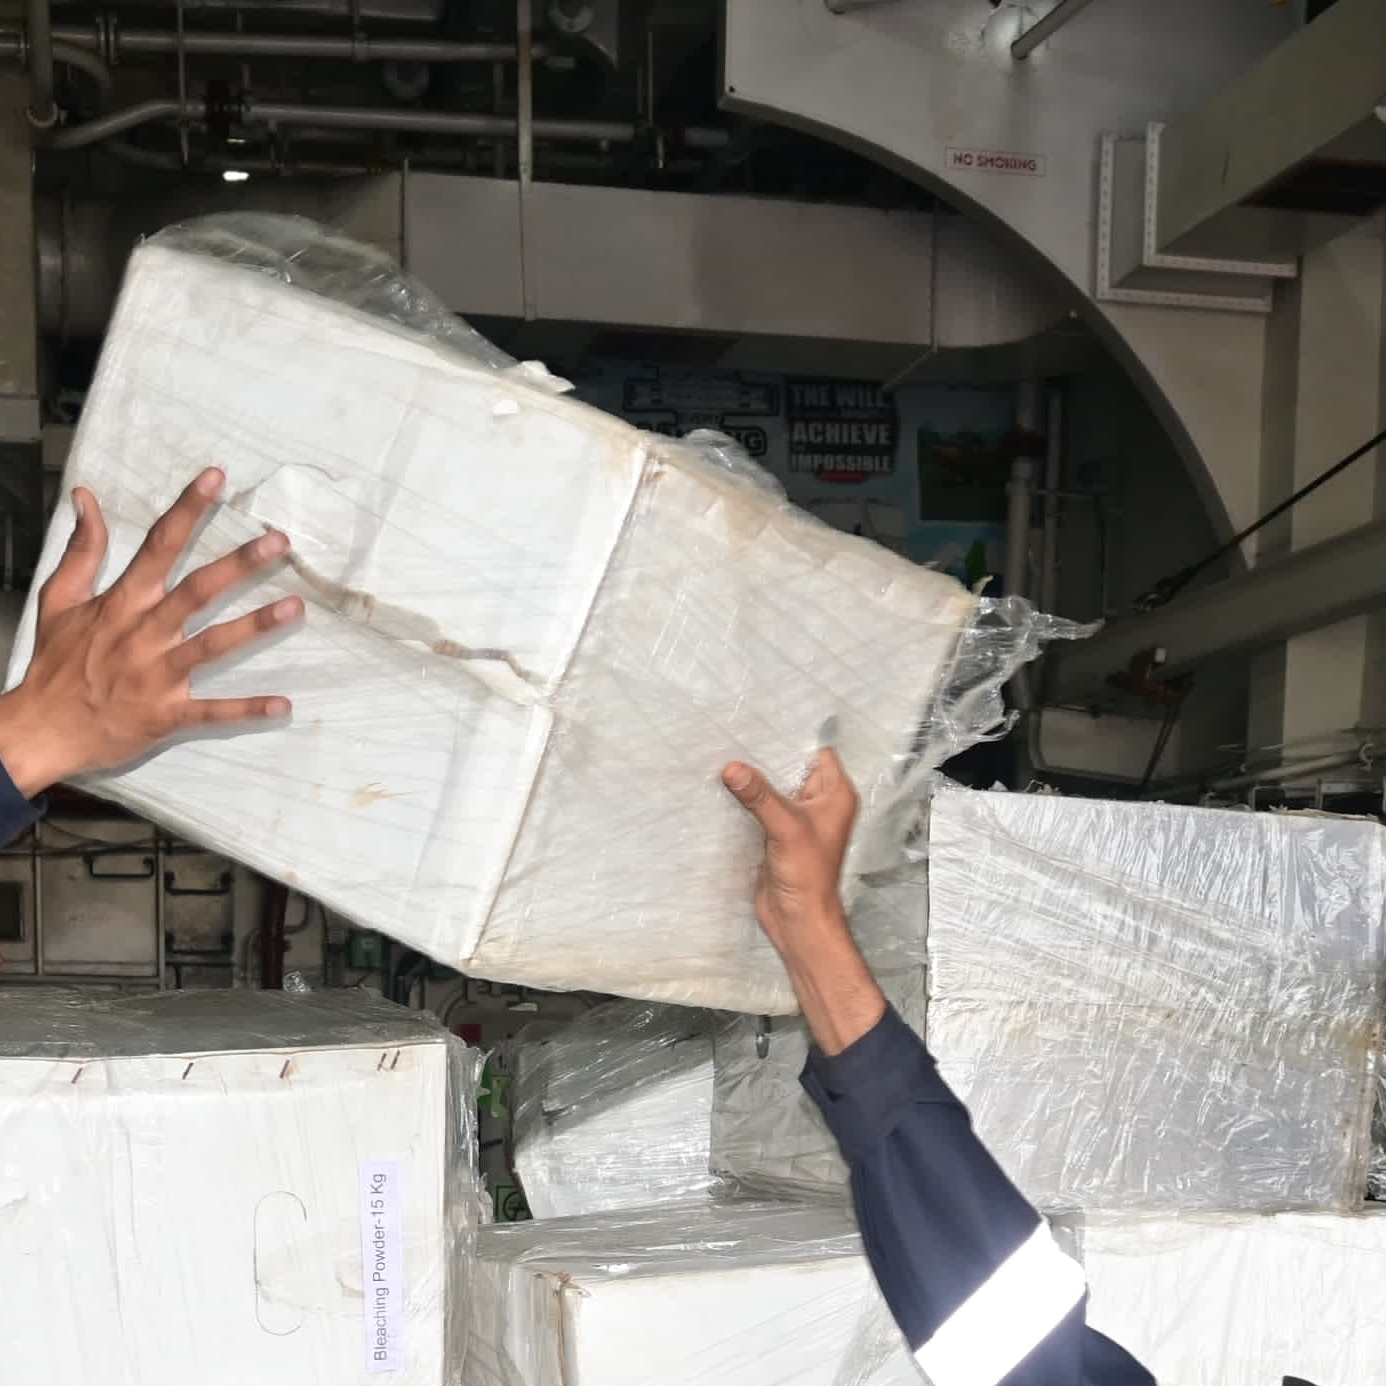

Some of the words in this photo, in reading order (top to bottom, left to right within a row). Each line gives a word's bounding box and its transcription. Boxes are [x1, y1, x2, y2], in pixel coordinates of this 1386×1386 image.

[953, 152, 974, 167] NO
[976, 154, 1037, 171] SMOKING
[792, 384, 830, 407] THE
[836, 385, 887, 408] WILL
[792, 422, 892, 446] ACHIEVE
[791, 453, 891, 473] IMPOSSIBLE
[370, 1173, 387, 1194] Kg
[370, 1199, 386, 1282] Powder-15
[373, 1287, 389, 1361] Bleaching
